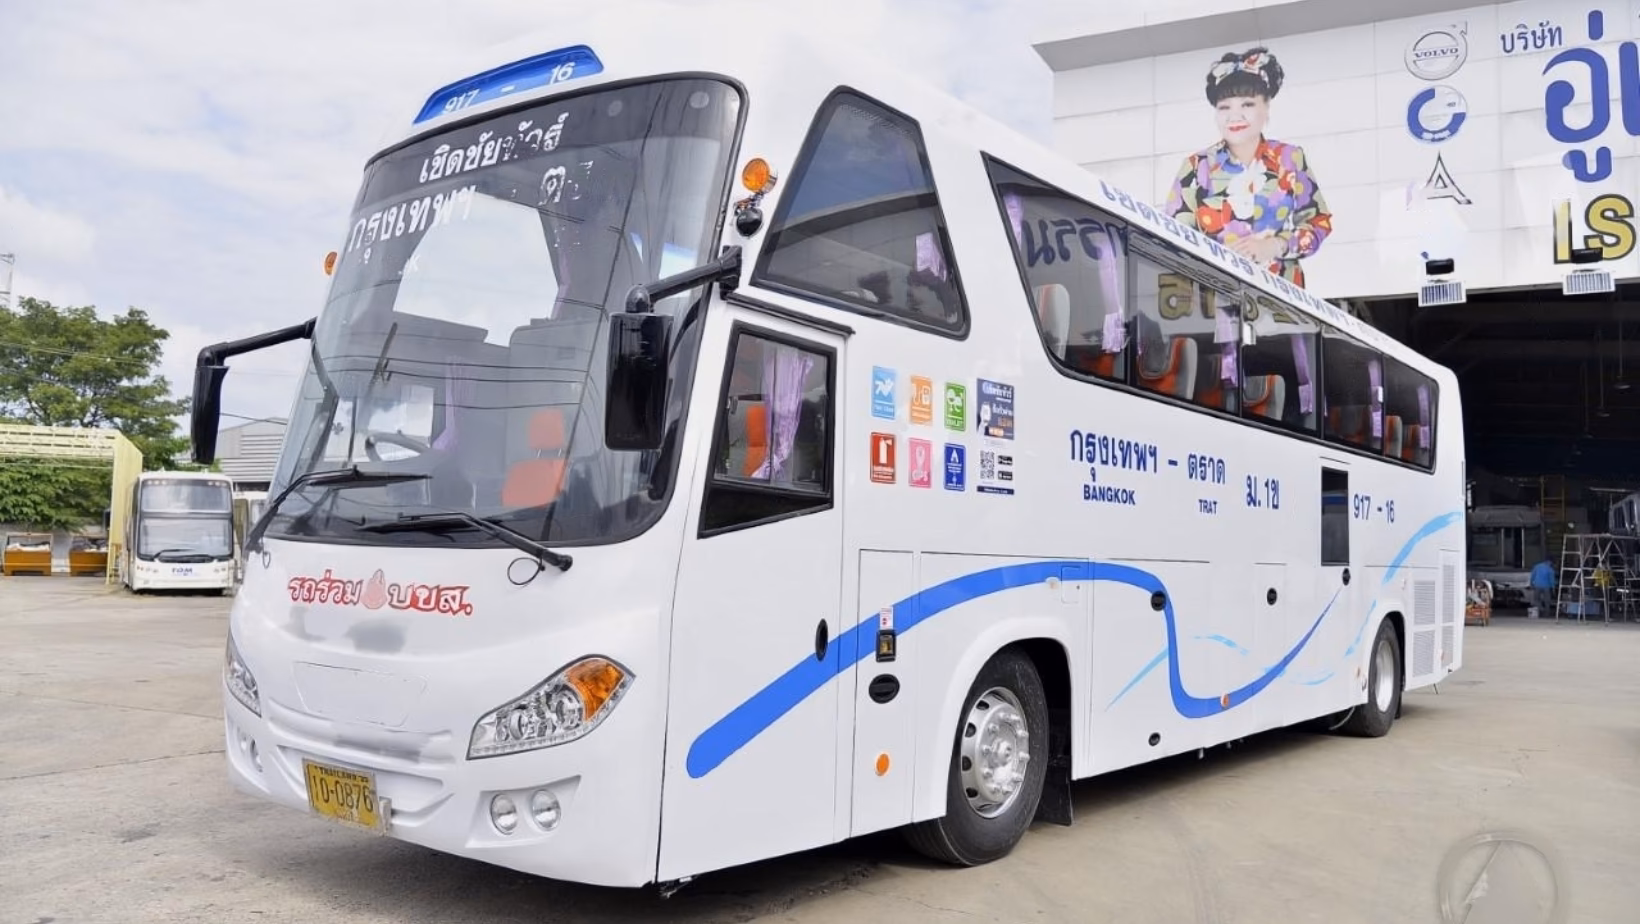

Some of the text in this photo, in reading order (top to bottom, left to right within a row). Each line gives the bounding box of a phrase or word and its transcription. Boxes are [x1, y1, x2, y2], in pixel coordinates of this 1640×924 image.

[1414, 47, 1459, 58] VOLVO
[1501, 20, 1562, 53] บริษัท
[443, 89, 480, 113] 917
[550, 62, 575, 84] 16
[1070, 429, 1157, 482] กรุงเทพฯ
[1188, 453, 1226, 485] ตราด
[1083, 484, 1136, 506] BANGKOK
[1198, 499, 1217, 515] TRAT
[1353, 493, 1371, 520] 917
[1385, 500, 1395, 524] 16
[288, 569, 473, 616] รถร่วม บขส.
